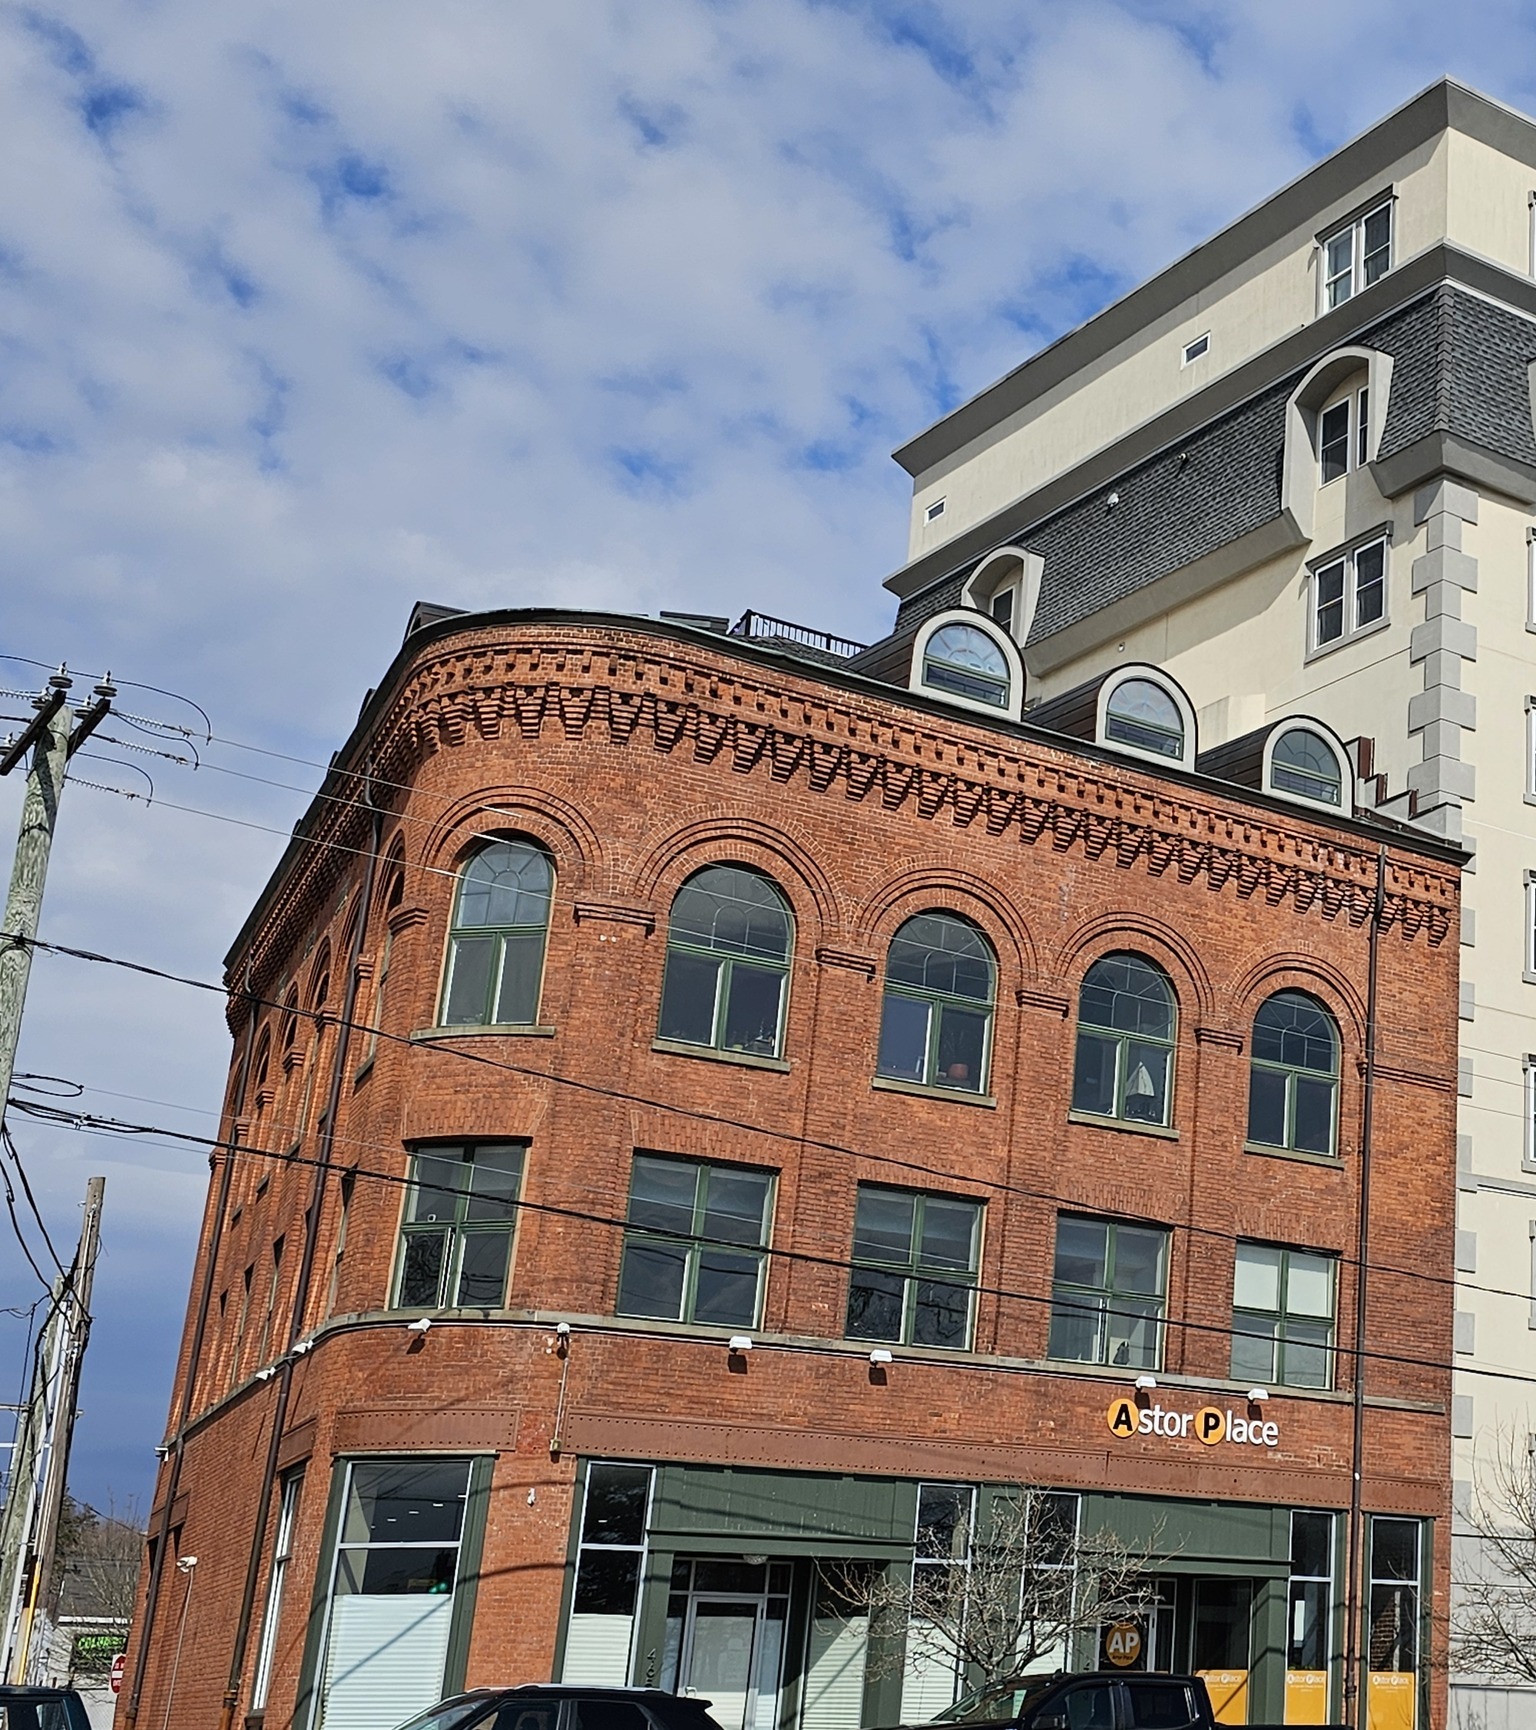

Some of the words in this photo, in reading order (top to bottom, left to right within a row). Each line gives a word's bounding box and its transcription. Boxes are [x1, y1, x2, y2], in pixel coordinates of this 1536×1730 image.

[1108, 1400, 1193, 1438] Astor
[1195, 1407, 1278, 1446] Place
[1109, 1632, 1139, 1653] AP
